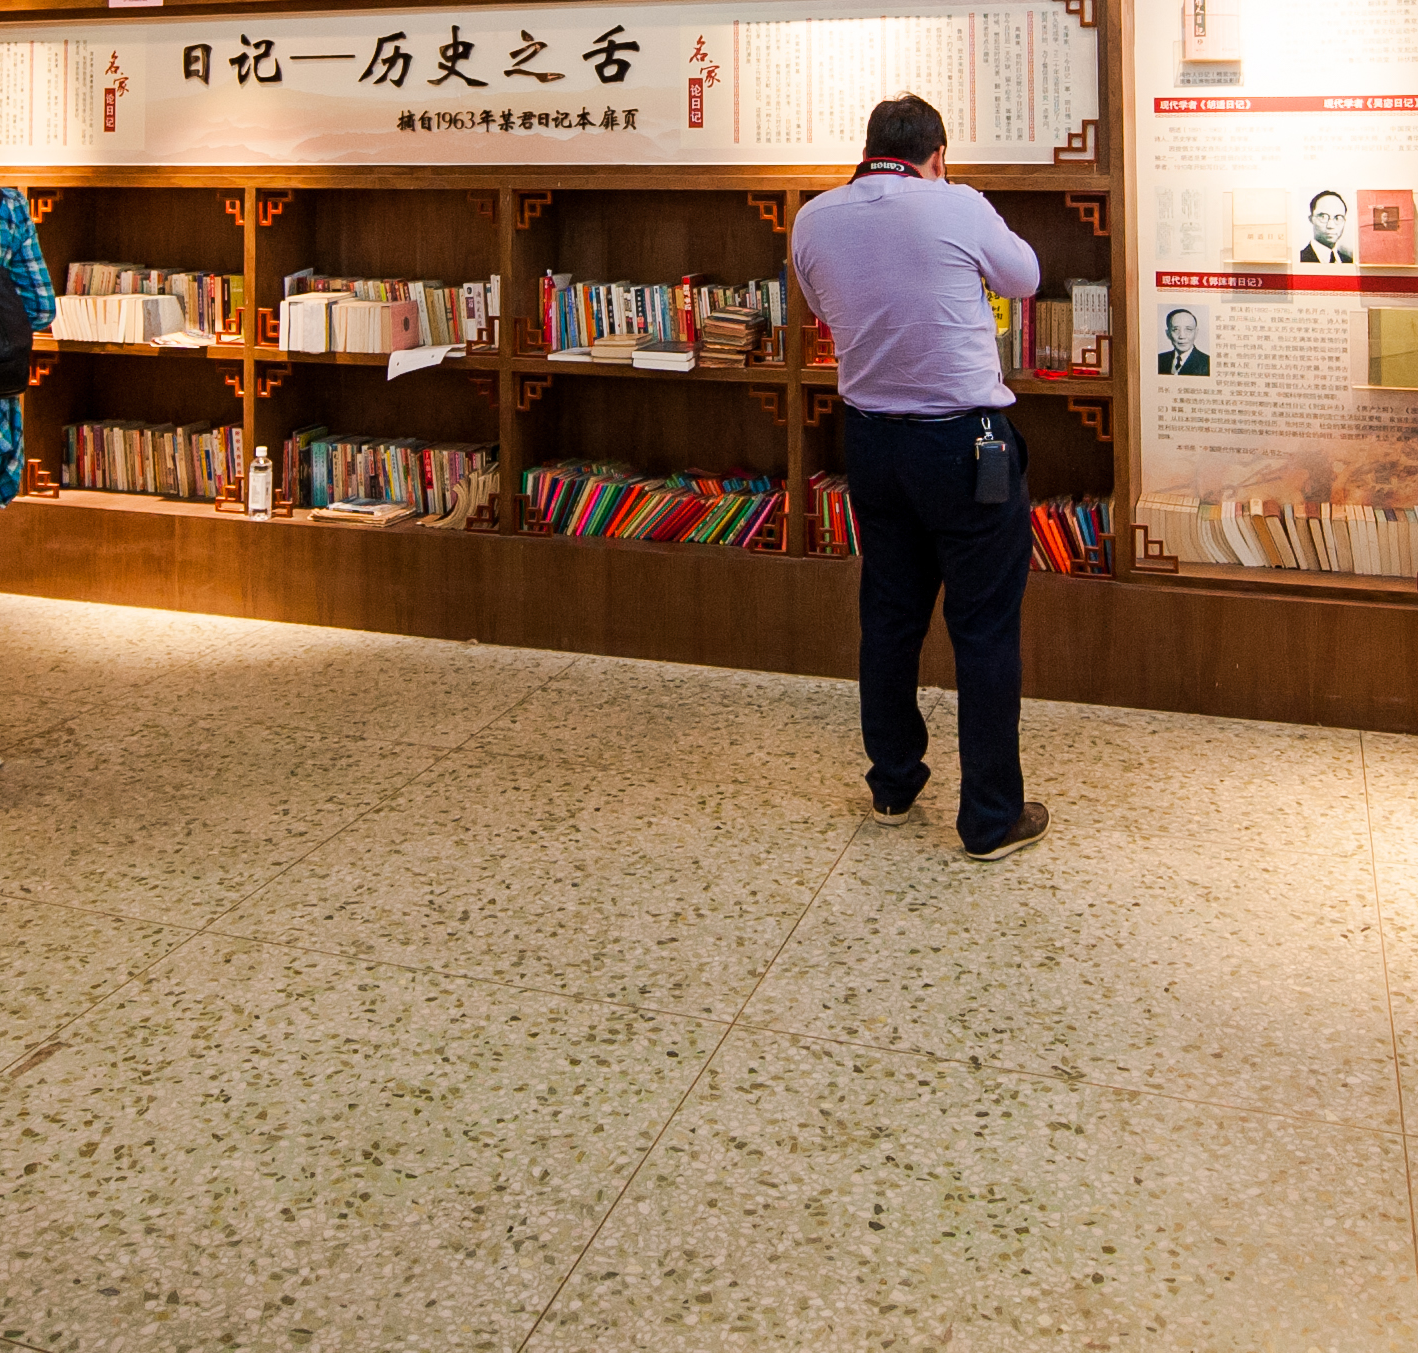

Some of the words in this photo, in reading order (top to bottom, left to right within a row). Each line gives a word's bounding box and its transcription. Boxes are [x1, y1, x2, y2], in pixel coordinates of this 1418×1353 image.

[688, 34, 721, 89] 名家
[105, 93, 115, 128] 论日记
[690, 84, 702, 123] 论日记
[1159, 99, 1252, 111] 现代学者《胡适日记》
[396, 108, 640, 134] 摘自1963年某君日记本扉页
[871, 161, 905, 172] Canon
[1162, 275, 1264, 287] 现代作家《郭沫若日记》
